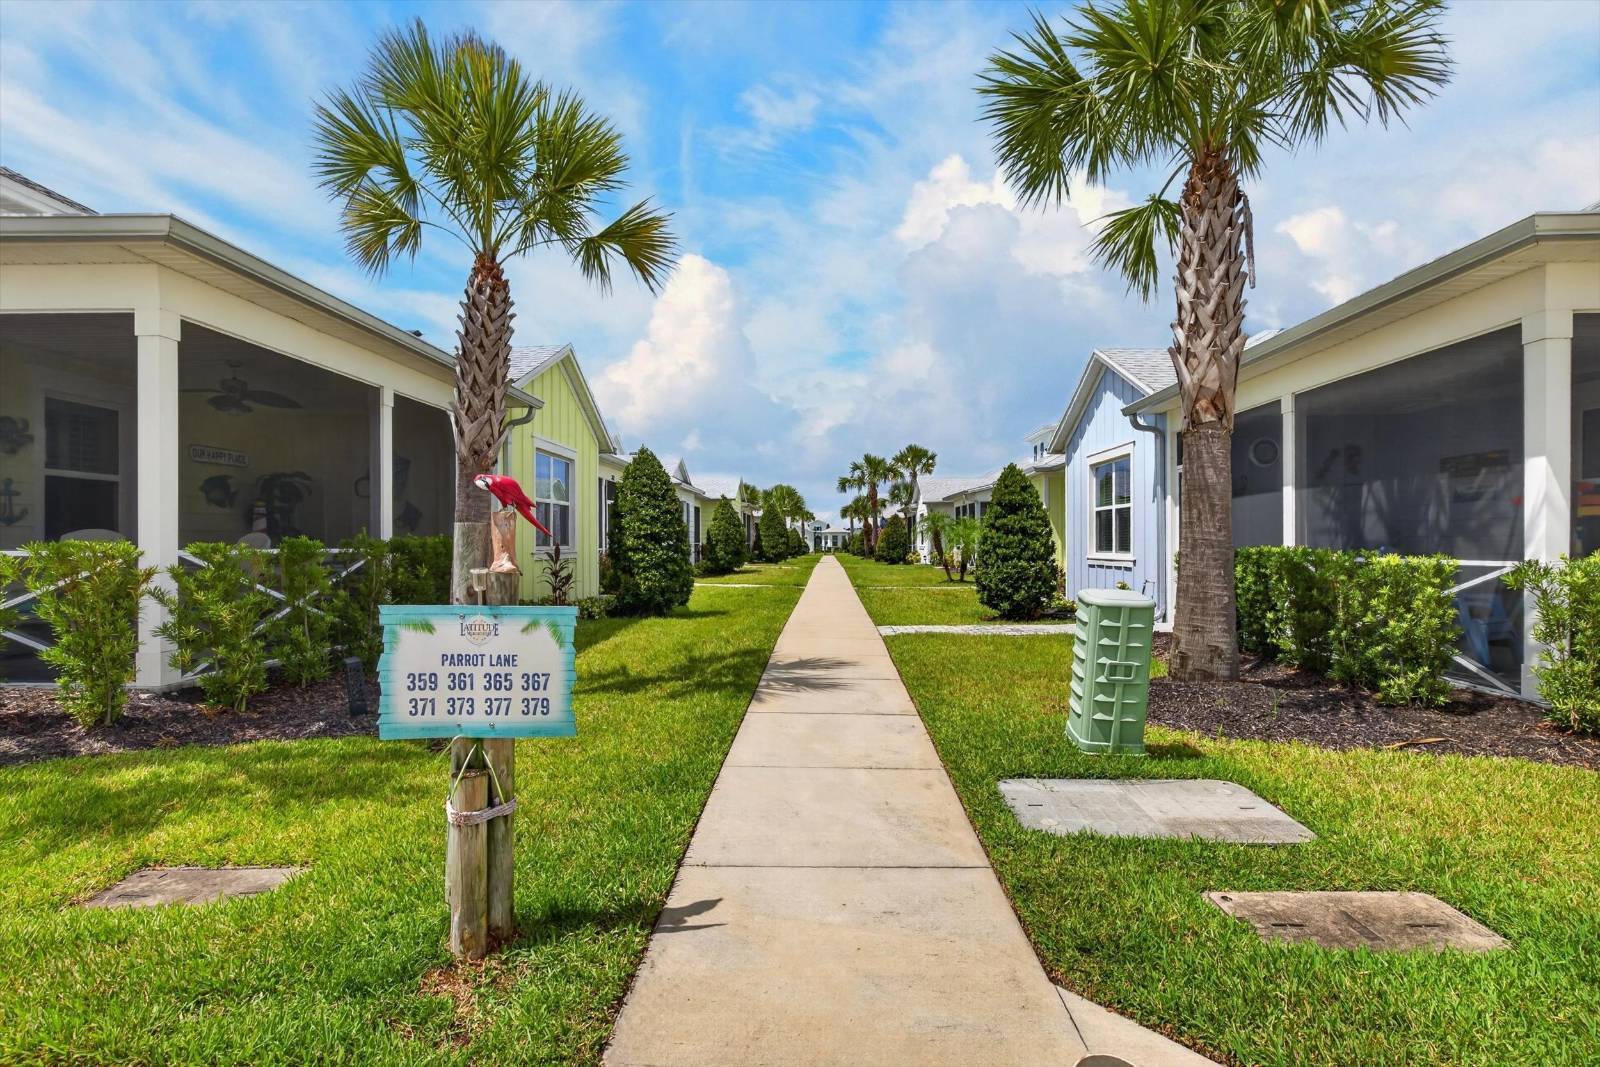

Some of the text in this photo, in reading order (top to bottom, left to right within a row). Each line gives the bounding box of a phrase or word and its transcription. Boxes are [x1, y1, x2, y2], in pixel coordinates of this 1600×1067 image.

[441, 653, 518, 667] PARROT LANE
[407, 672, 551, 692] 359 361 365 367
[408, 697, 550, 716] 371 373 377 379
